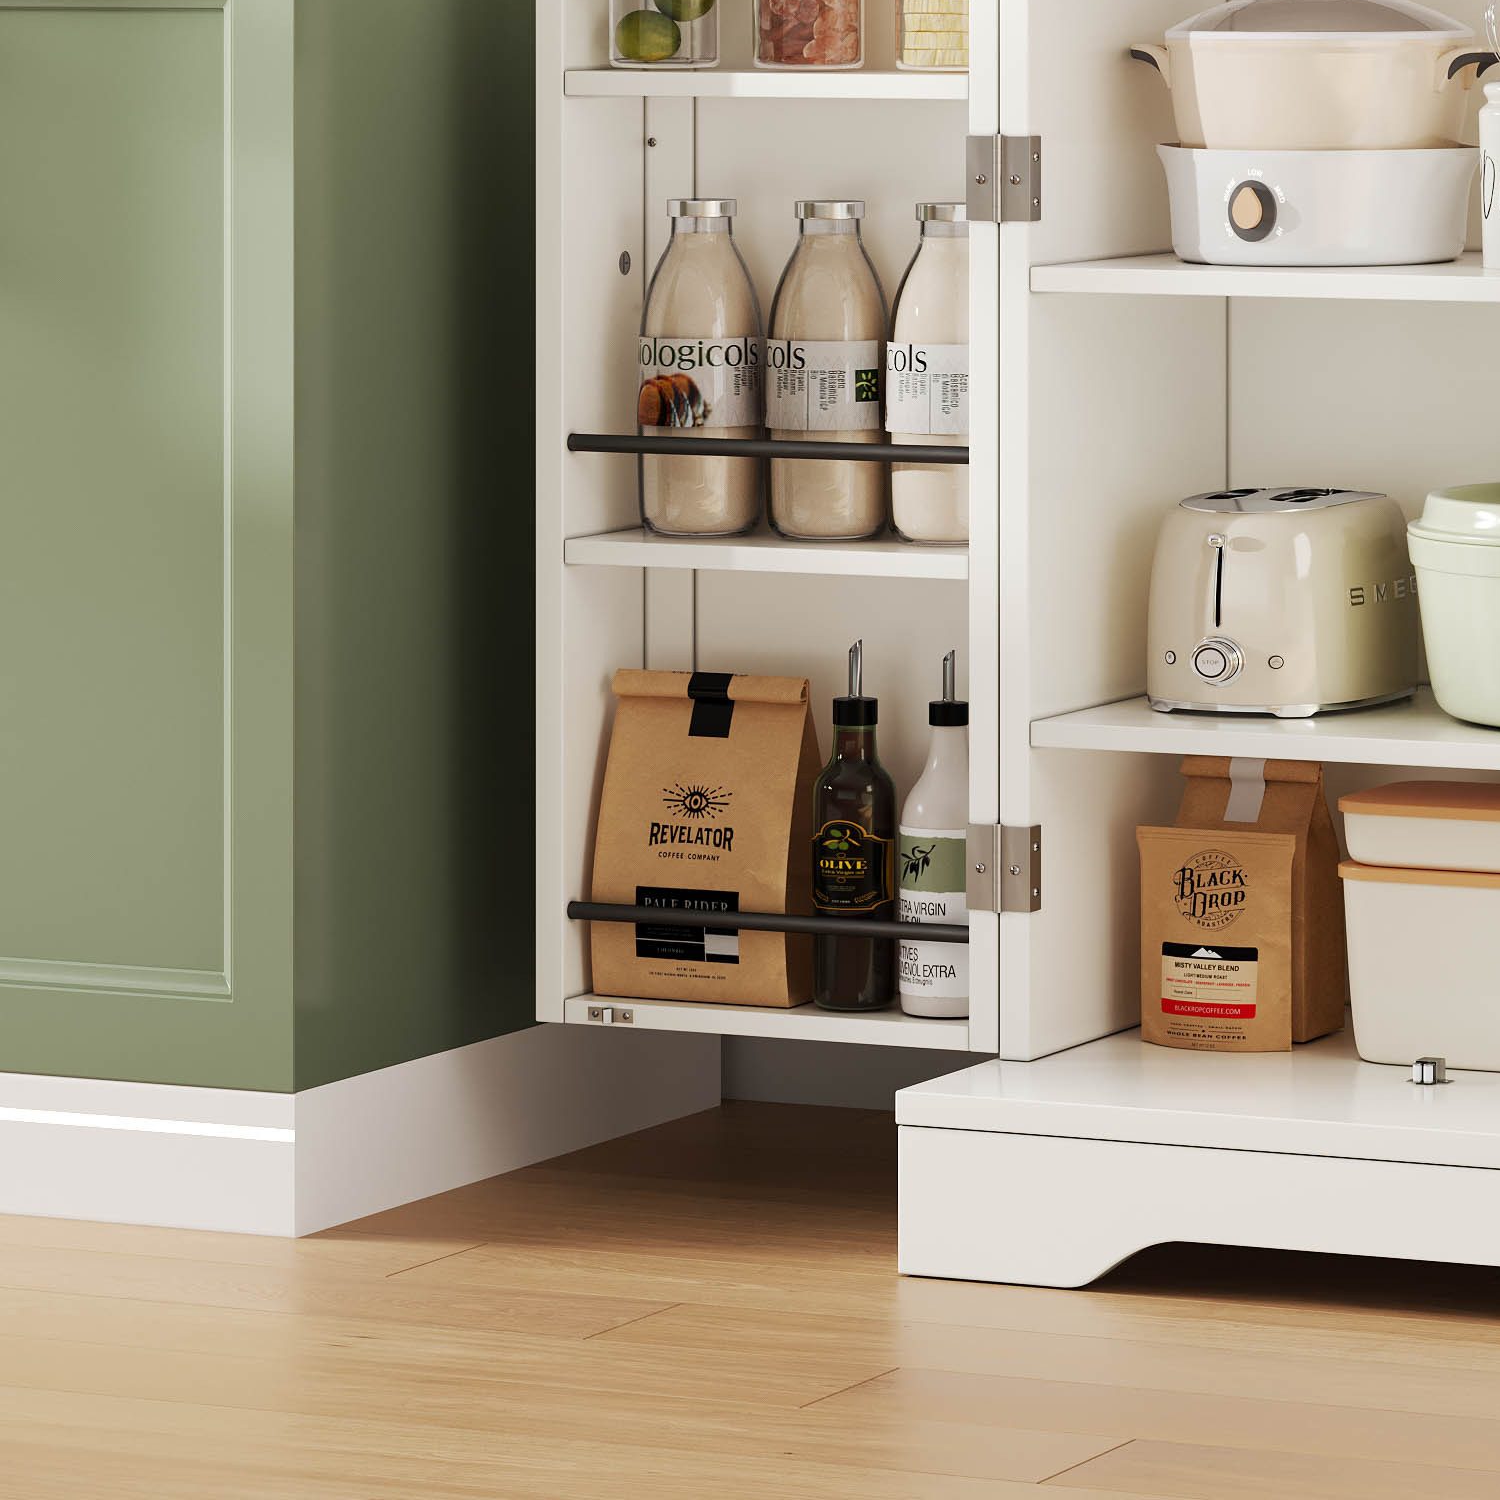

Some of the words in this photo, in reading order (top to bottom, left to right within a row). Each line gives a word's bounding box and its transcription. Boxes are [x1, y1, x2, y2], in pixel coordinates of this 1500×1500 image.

[1248, 168, 1263, 177] LOW
[649, 823, 733, 852] REVELATOR
[688, 853, 720, 861] COMPANY
[1196, 855, 1231, 865] COFFEE
[820, 860, 867, 869] OLIVE
[1173, 867, 1245, 900] BLACK
[685, 900, 728, 911] RIDER
[914, 902, 946, 916] VIRGIN
[1192, 891, 1245, 918] DROP
[1197, 913, 1234, 927] ROASTERS
[922, 965, 956, 978] EXTRA
